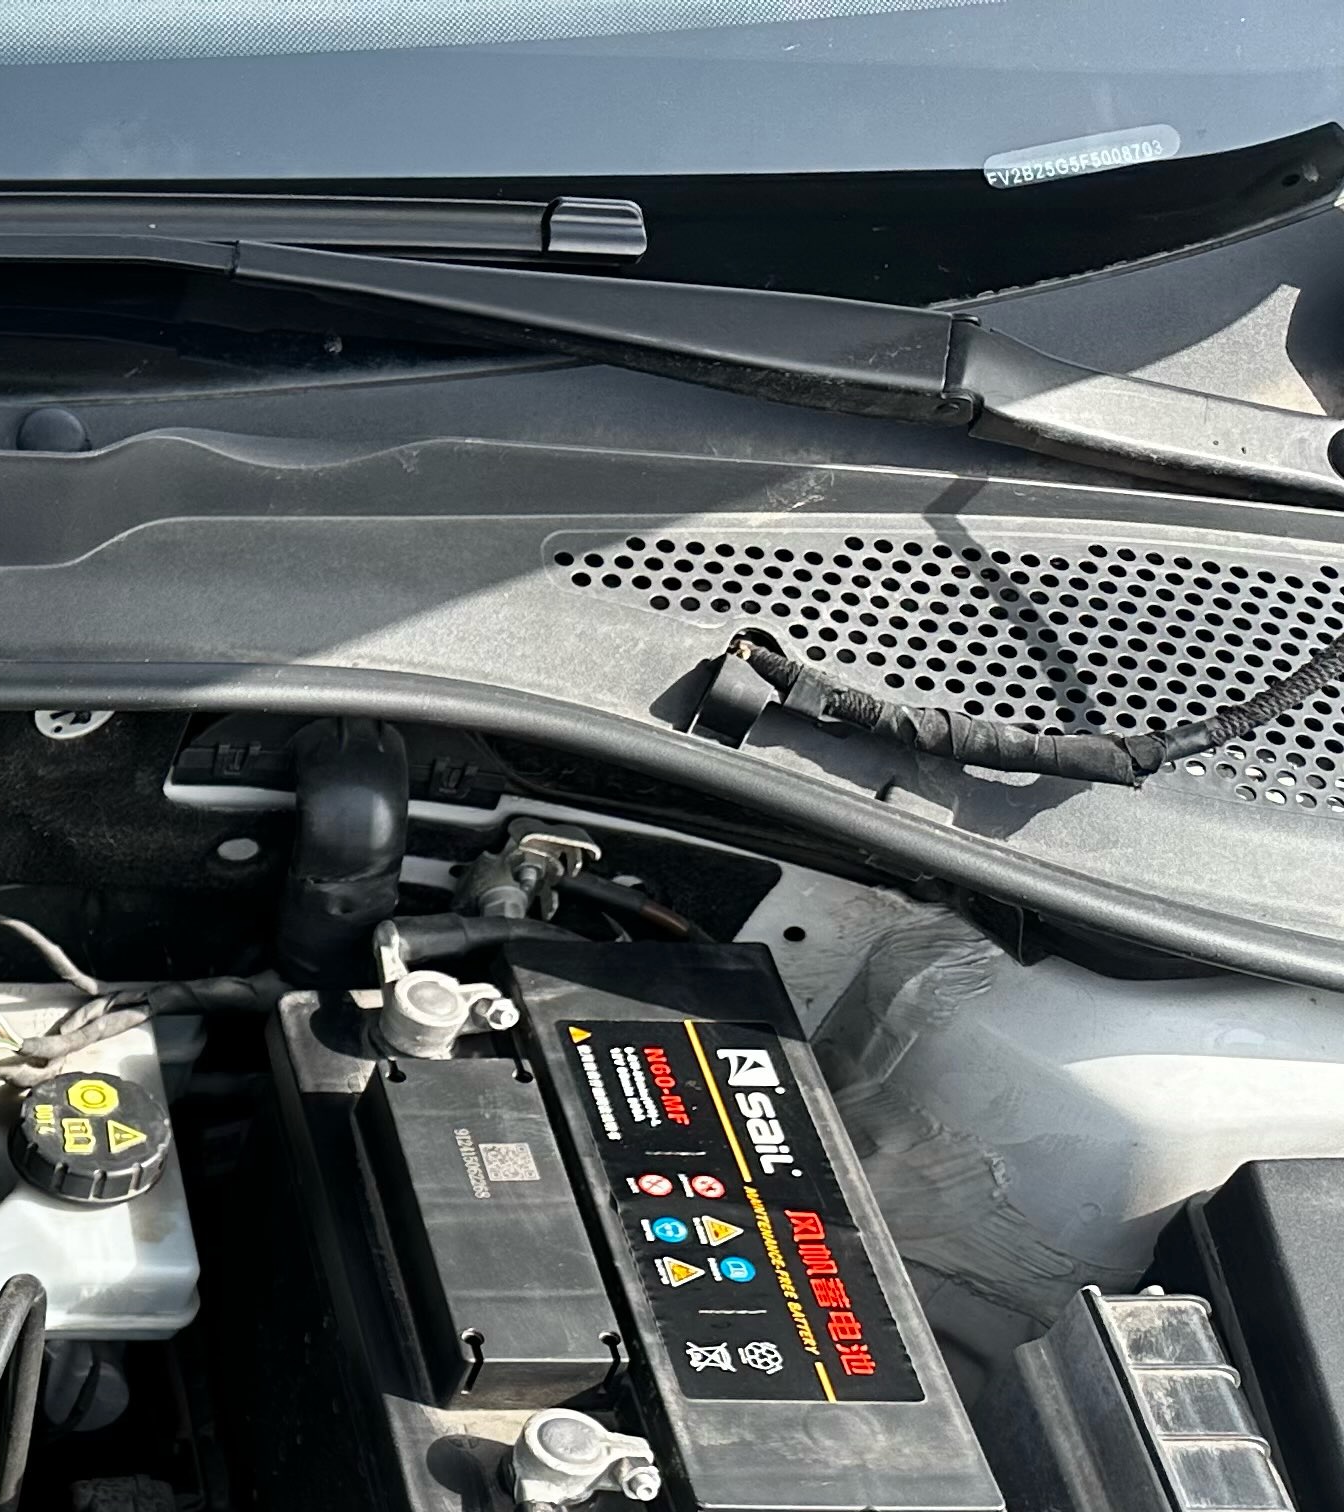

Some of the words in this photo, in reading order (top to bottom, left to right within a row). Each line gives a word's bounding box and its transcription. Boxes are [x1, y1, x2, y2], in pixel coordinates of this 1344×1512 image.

[35, 1104, 55, 1125] DOT
[643, 1047, 691, 1126] N60-MF
[784, 1209, 876, 1376] 风帆蓄电池
[787, 1301, 820, 1356] BATTERY
